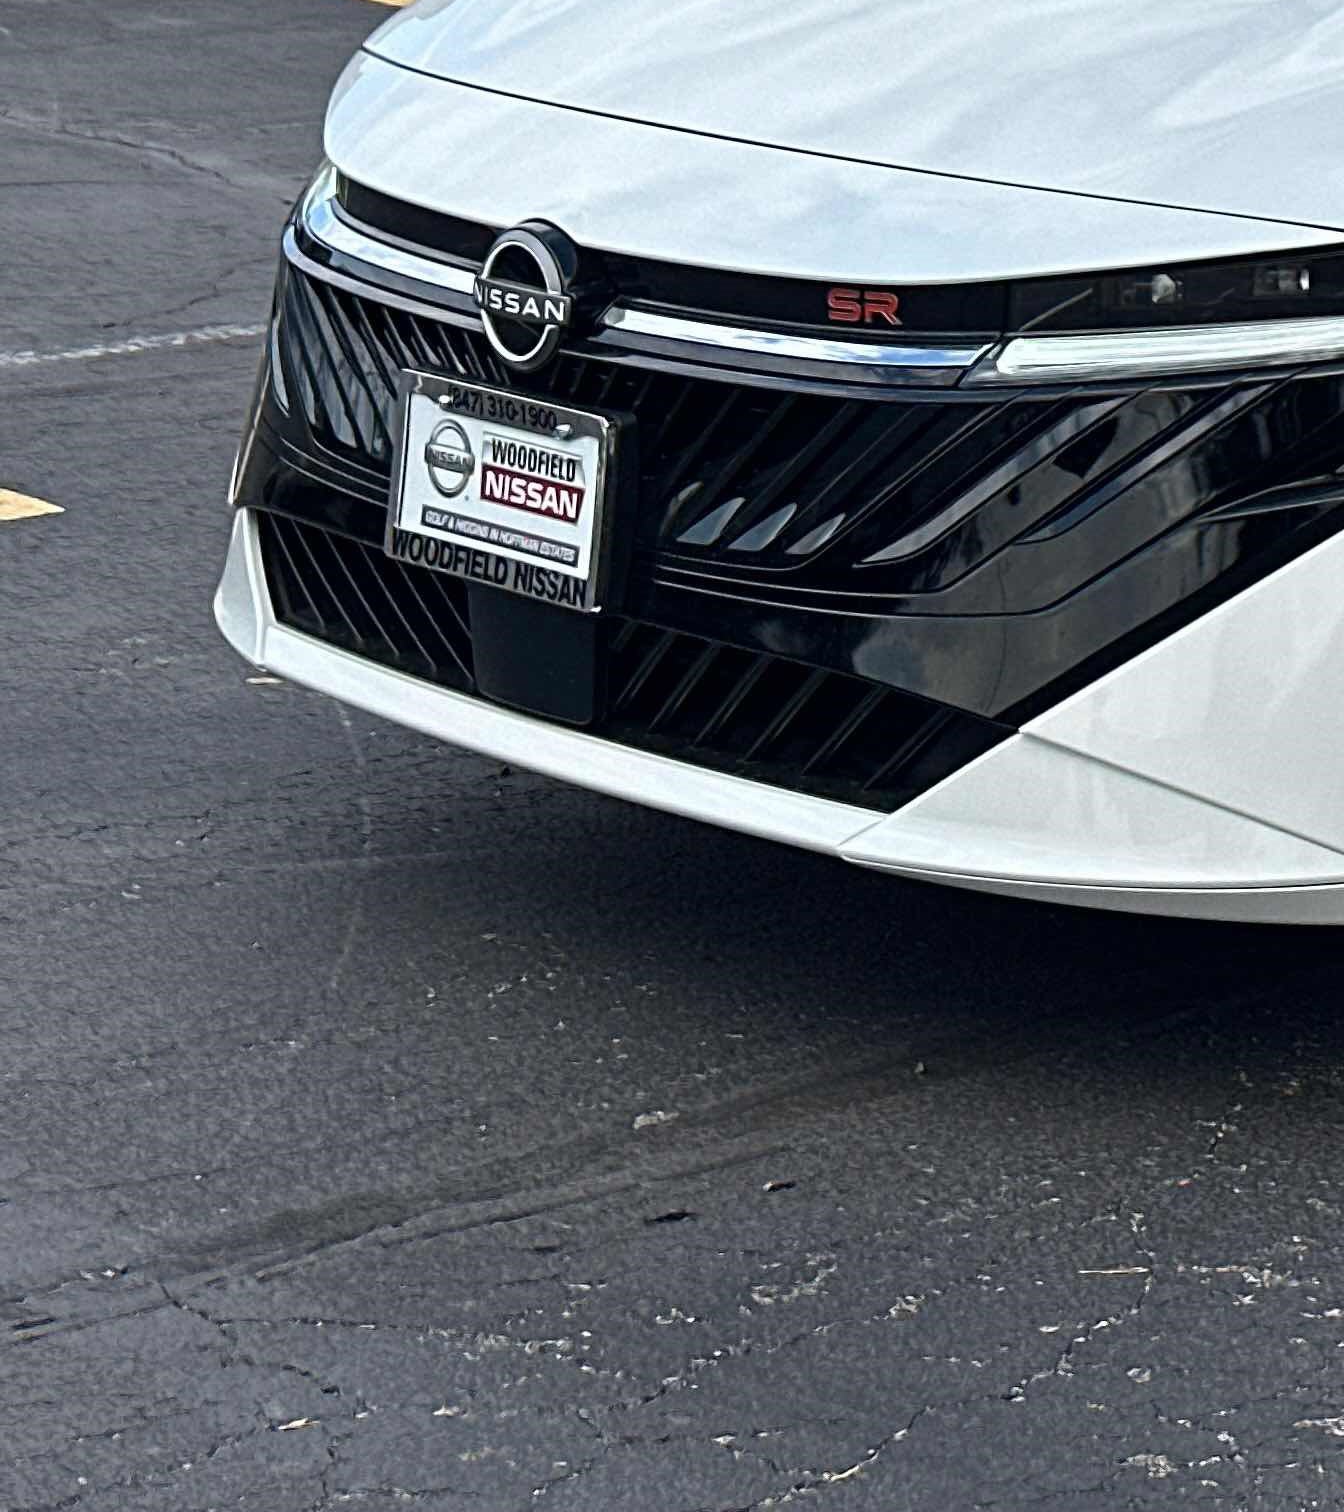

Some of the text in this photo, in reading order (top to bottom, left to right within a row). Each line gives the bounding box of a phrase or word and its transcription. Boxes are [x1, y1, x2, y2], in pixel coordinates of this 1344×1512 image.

[473, 280, 565, 322] NISSAN
[828, 288, 903, 325] SR
[432, 449, 469, 466] NISSAN
[491, 438, 576, 482] WOODFIELD
[484, 470, 579, 519] NISSAN
[392, 529, 588, 609] WOODFIELD NISSAN
